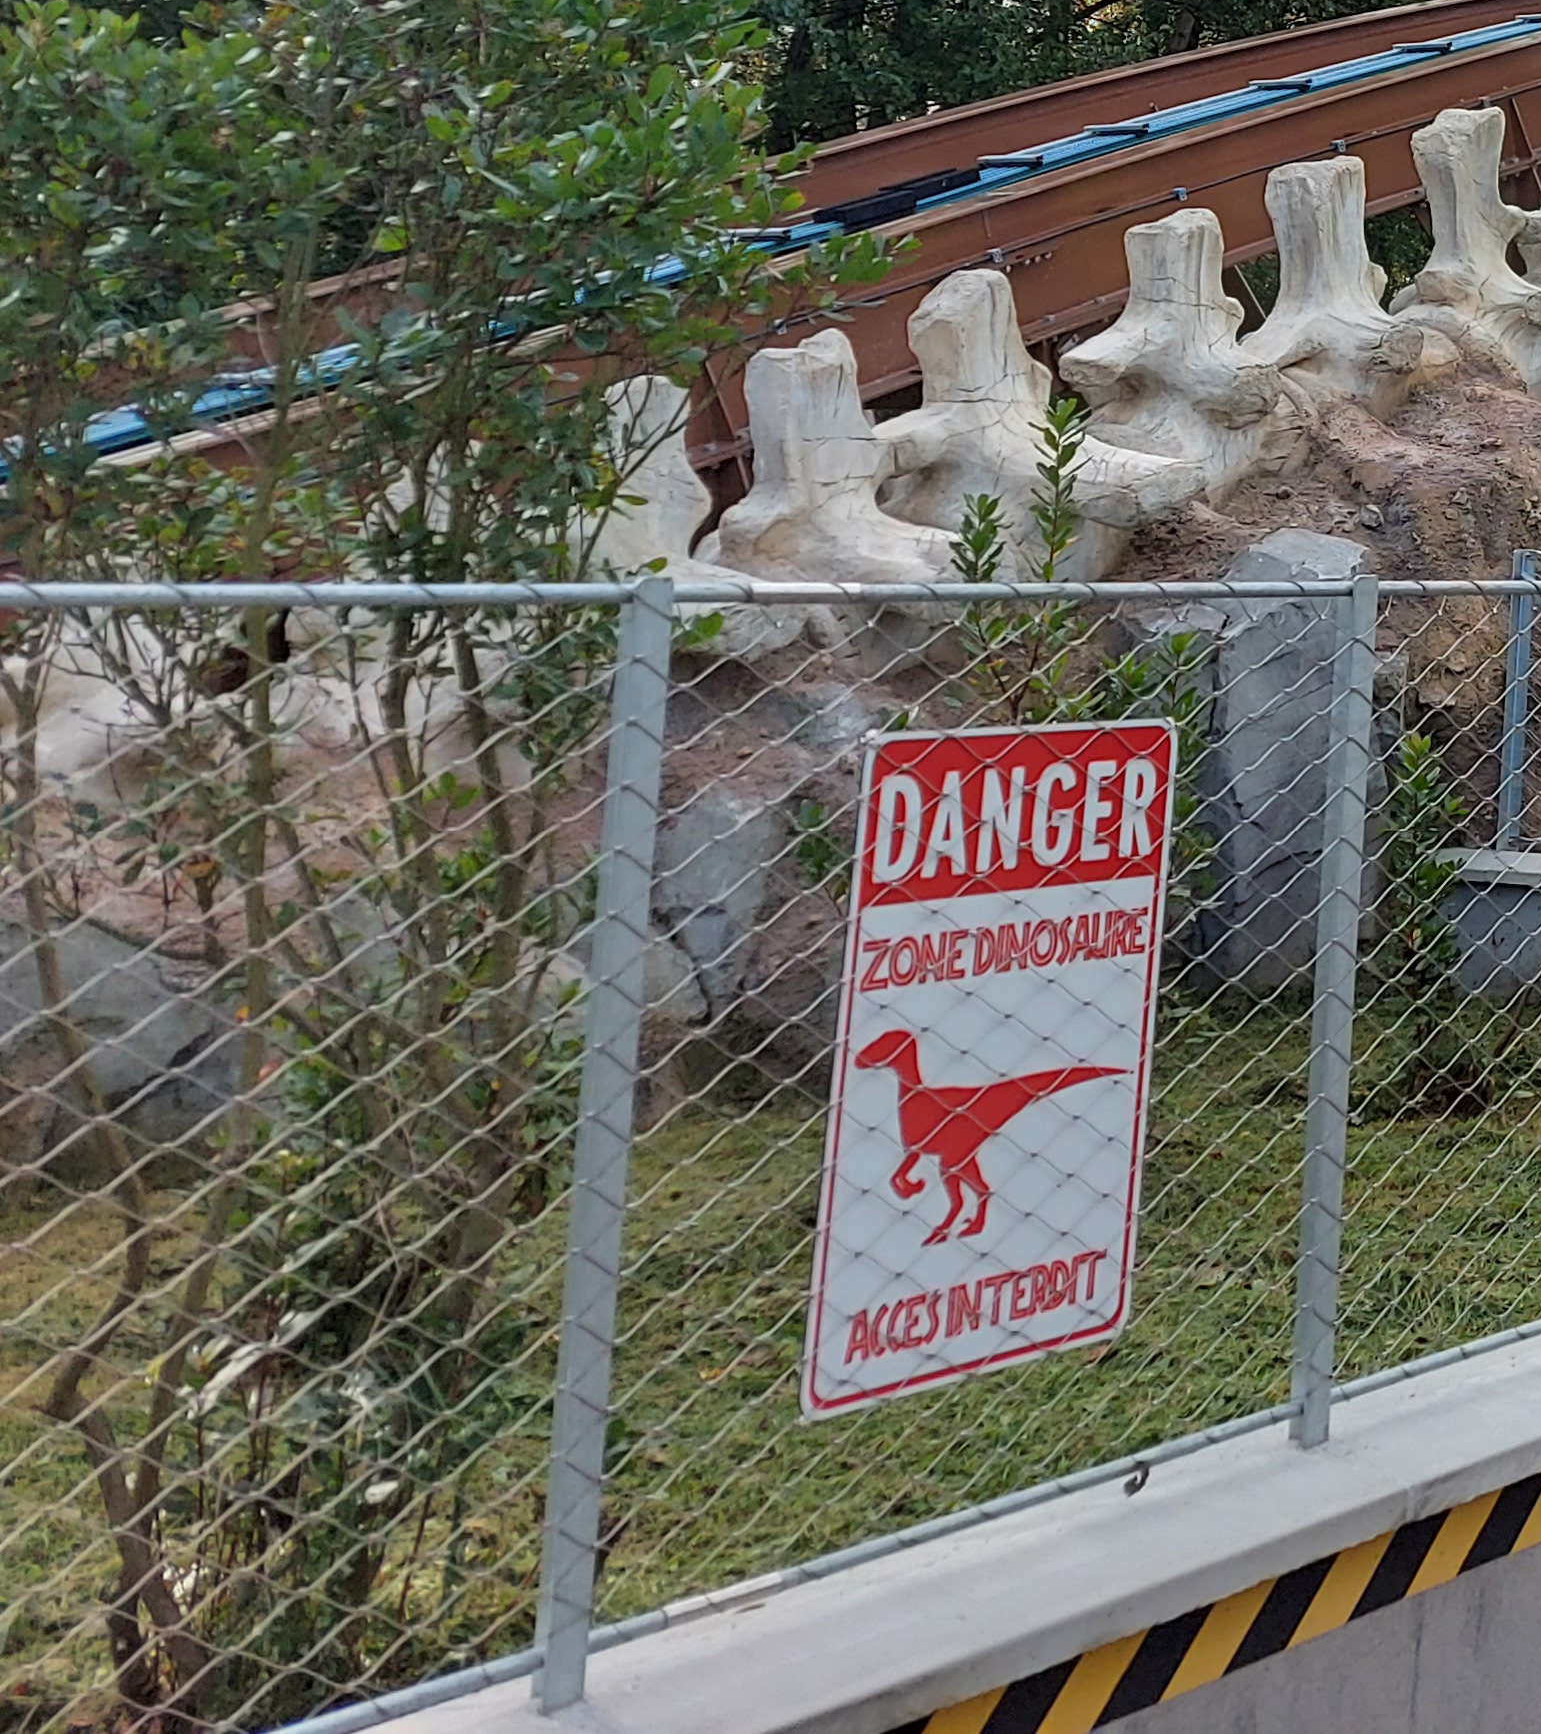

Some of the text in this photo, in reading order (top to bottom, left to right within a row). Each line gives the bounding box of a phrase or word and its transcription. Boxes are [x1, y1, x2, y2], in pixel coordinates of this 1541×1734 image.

[872, 759, 1157, 884] DANGER
[860, 907, 1149, 992] ZONE DINOSAURE
[844, 1249, 1107, 1365] ACCES INTERDIT
